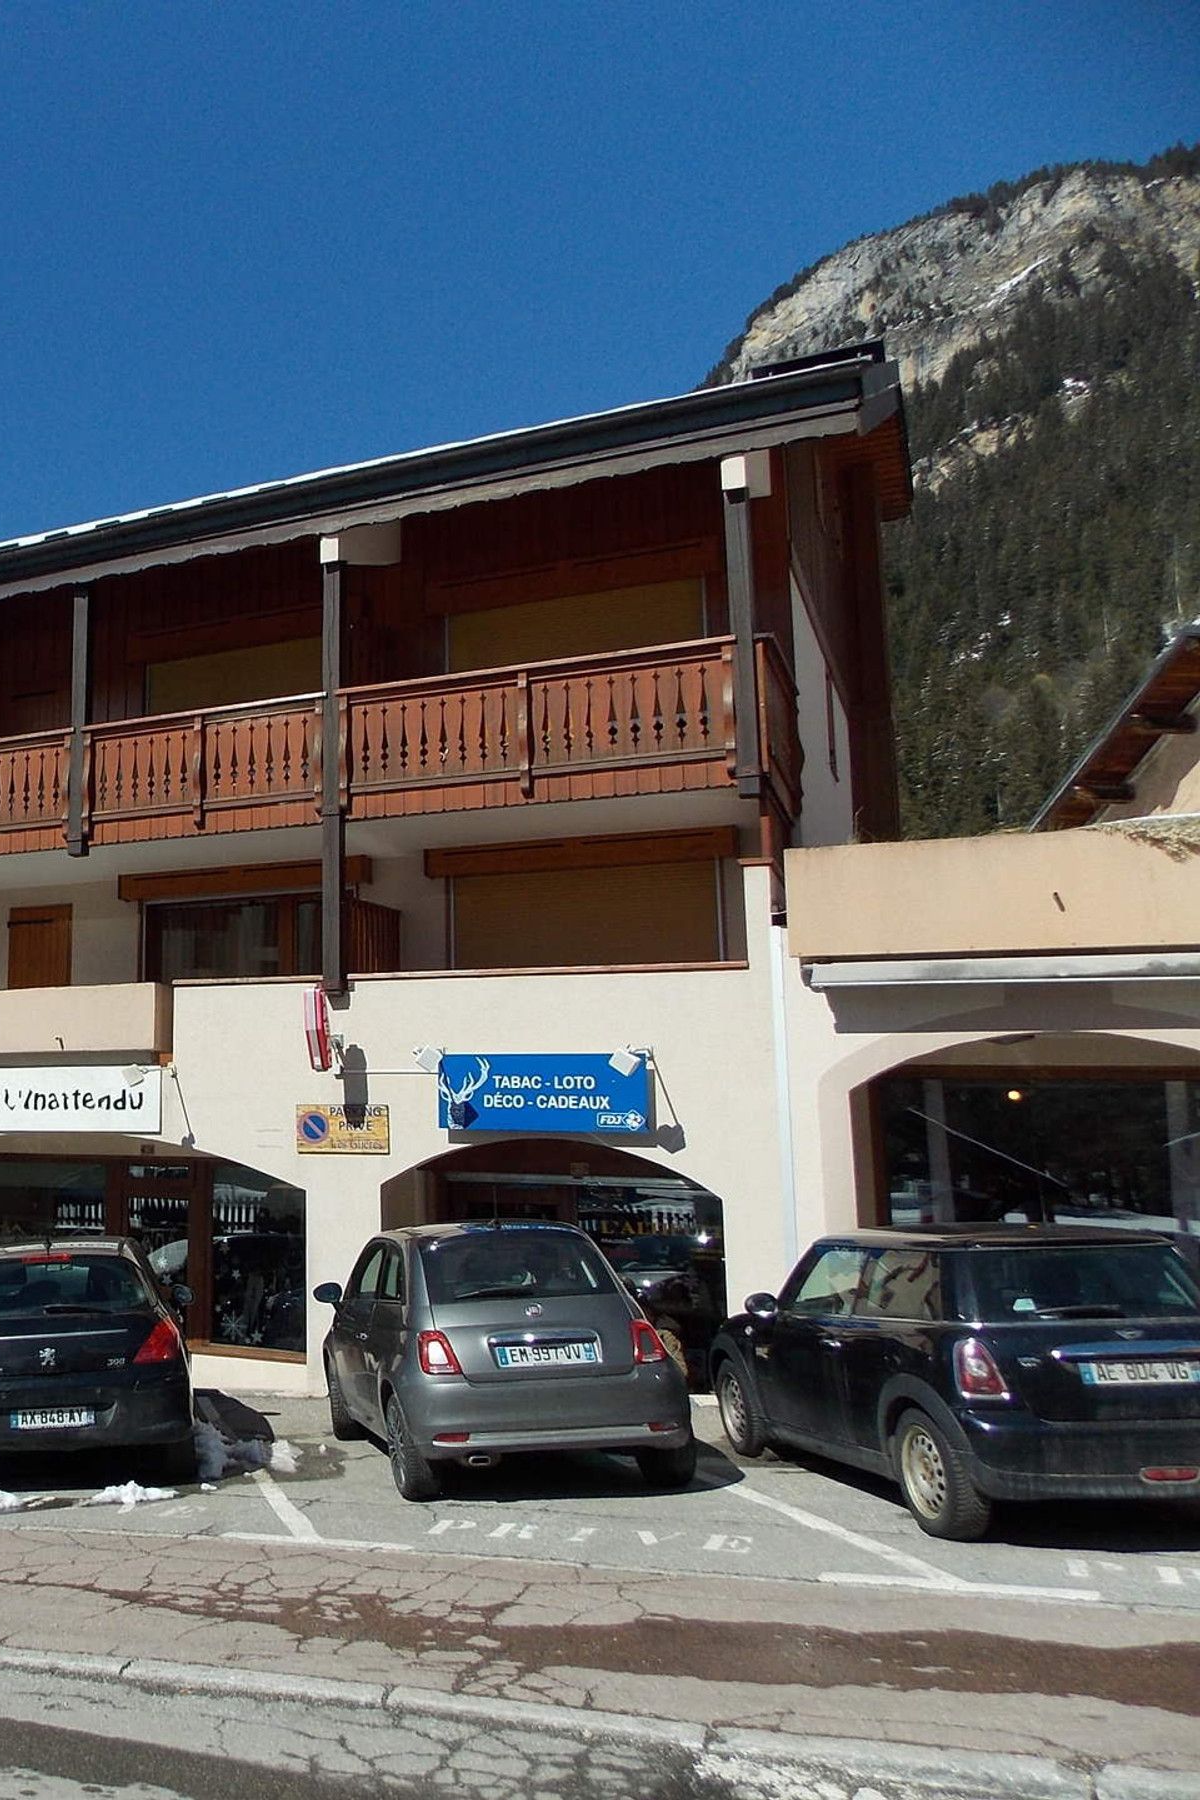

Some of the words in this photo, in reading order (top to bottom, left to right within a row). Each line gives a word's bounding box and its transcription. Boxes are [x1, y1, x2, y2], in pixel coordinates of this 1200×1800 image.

[492, 1075, 542, 1089] TABAC
[554, 1075, 595, 1090] LOTO
[3, 1088, 143, 1110] L'Inattendu
[483, 1091, 524, 1108] DÉCO
[536, 1094, 610, 1110] CADEAUX
[329, 1106, 381, 1117] PARNG
[600, 1115, 622, 1125] FDJ
[424, 1519, 754, 1552] PRIVE
